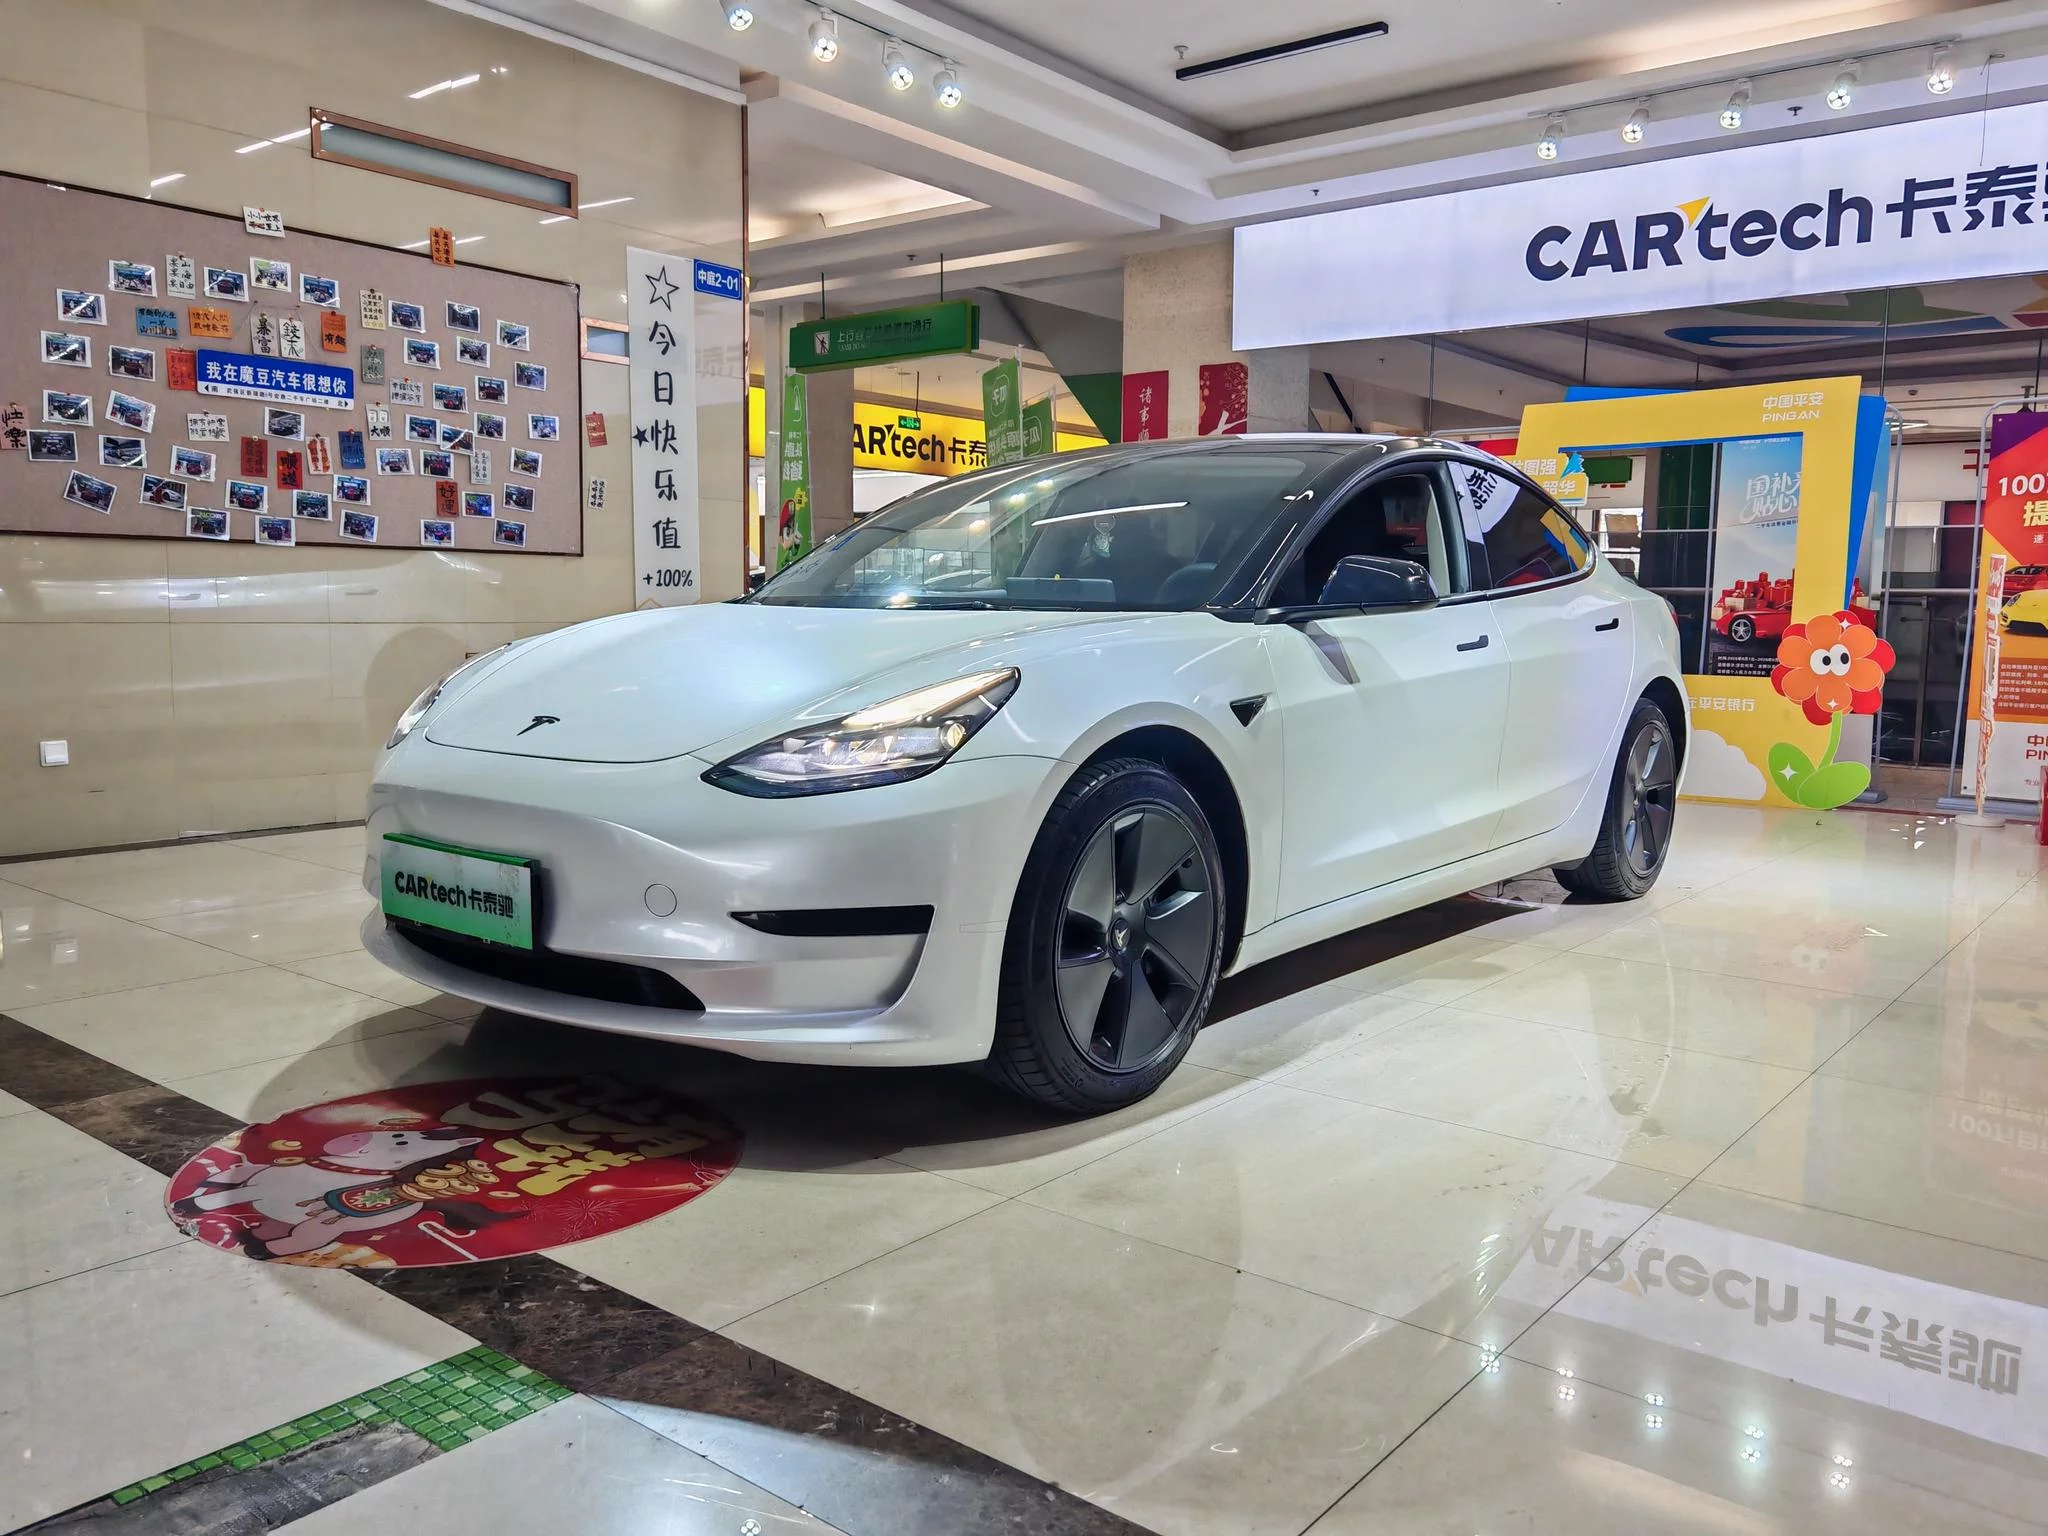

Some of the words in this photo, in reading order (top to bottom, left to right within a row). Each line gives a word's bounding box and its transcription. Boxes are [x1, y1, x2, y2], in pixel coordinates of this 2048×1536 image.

[1525, 189, 1873, 281] CARtech
[1886, 164, 2048, 238] 卡泰
[698, 268, 739, 292] 中庭2-01
[206, 361, 347, 395] 我在魔豆汽车很想你
[1762, 392, 1824, 409] 中国平安
[648, 320, 682, 549] 今日快乐值
[1999, 473, 2048, 496] 100
[2027, 734, 2048, 747] 中
[394, 871, 467, 908] CARtech
[468, 887, 514, 919] 卡泰驰
